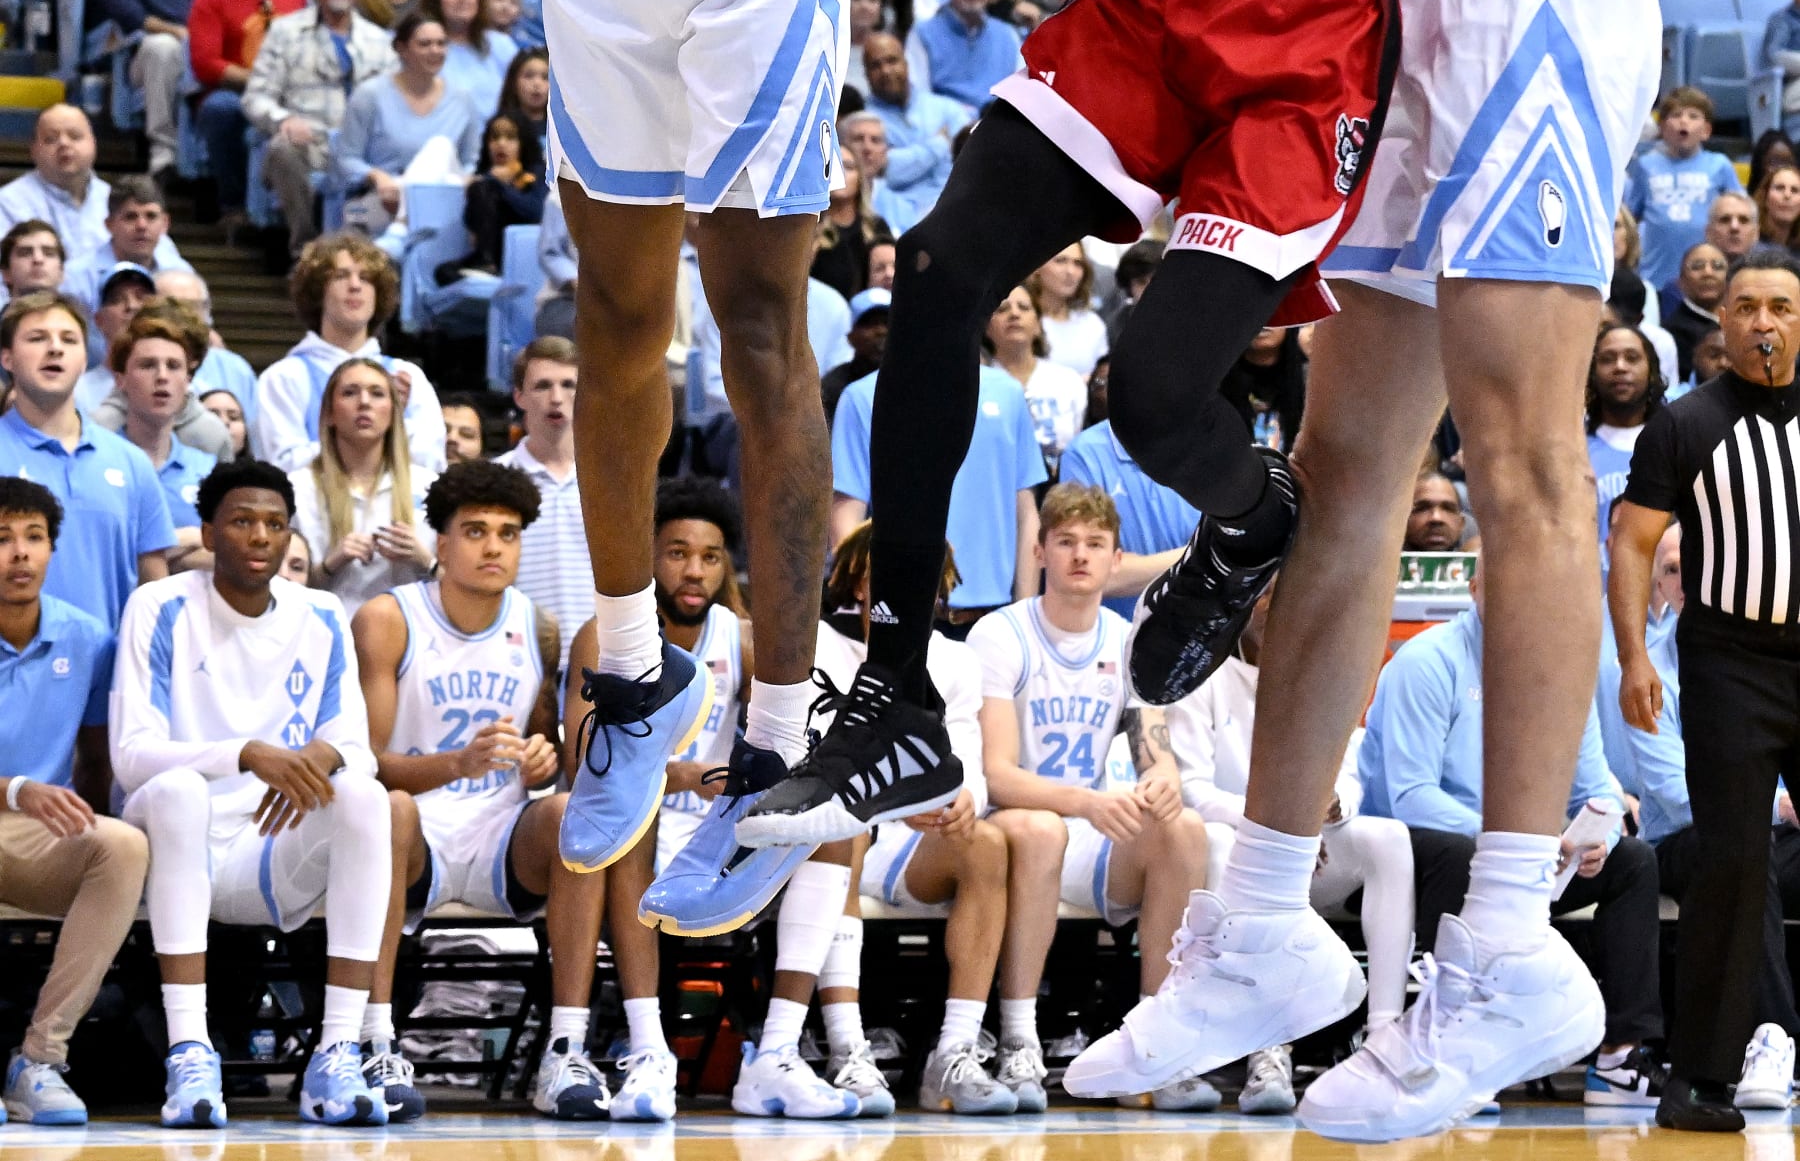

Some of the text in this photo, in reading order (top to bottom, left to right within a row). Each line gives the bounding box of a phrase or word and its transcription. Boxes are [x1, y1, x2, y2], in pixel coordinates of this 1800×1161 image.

[1177, 218, 1245, 252] PACK
[426, 670, 520, 707] NORTH
[1030, 695, 1112, 729] NORTH
[1036, 731, 1096, 778] 24
